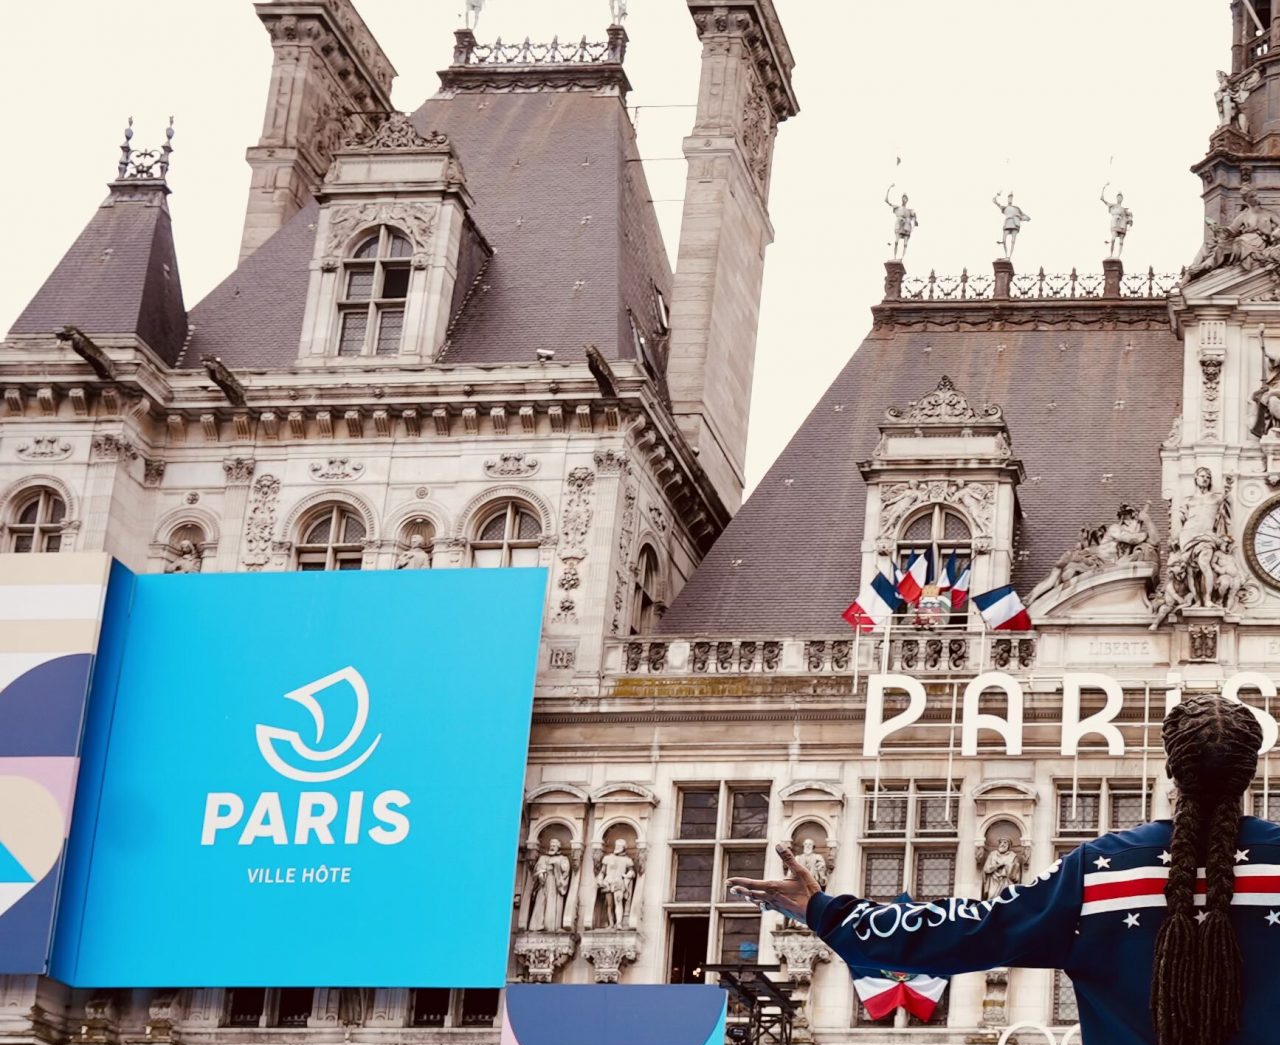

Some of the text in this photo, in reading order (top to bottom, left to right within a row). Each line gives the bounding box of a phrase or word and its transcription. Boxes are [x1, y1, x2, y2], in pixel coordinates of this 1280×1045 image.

[1088, 639, 1151, 656] LIBERTÉ
[201, 789, 411, 846] PARIS
[247, 864, 351, 884] VILLE HÔTE
